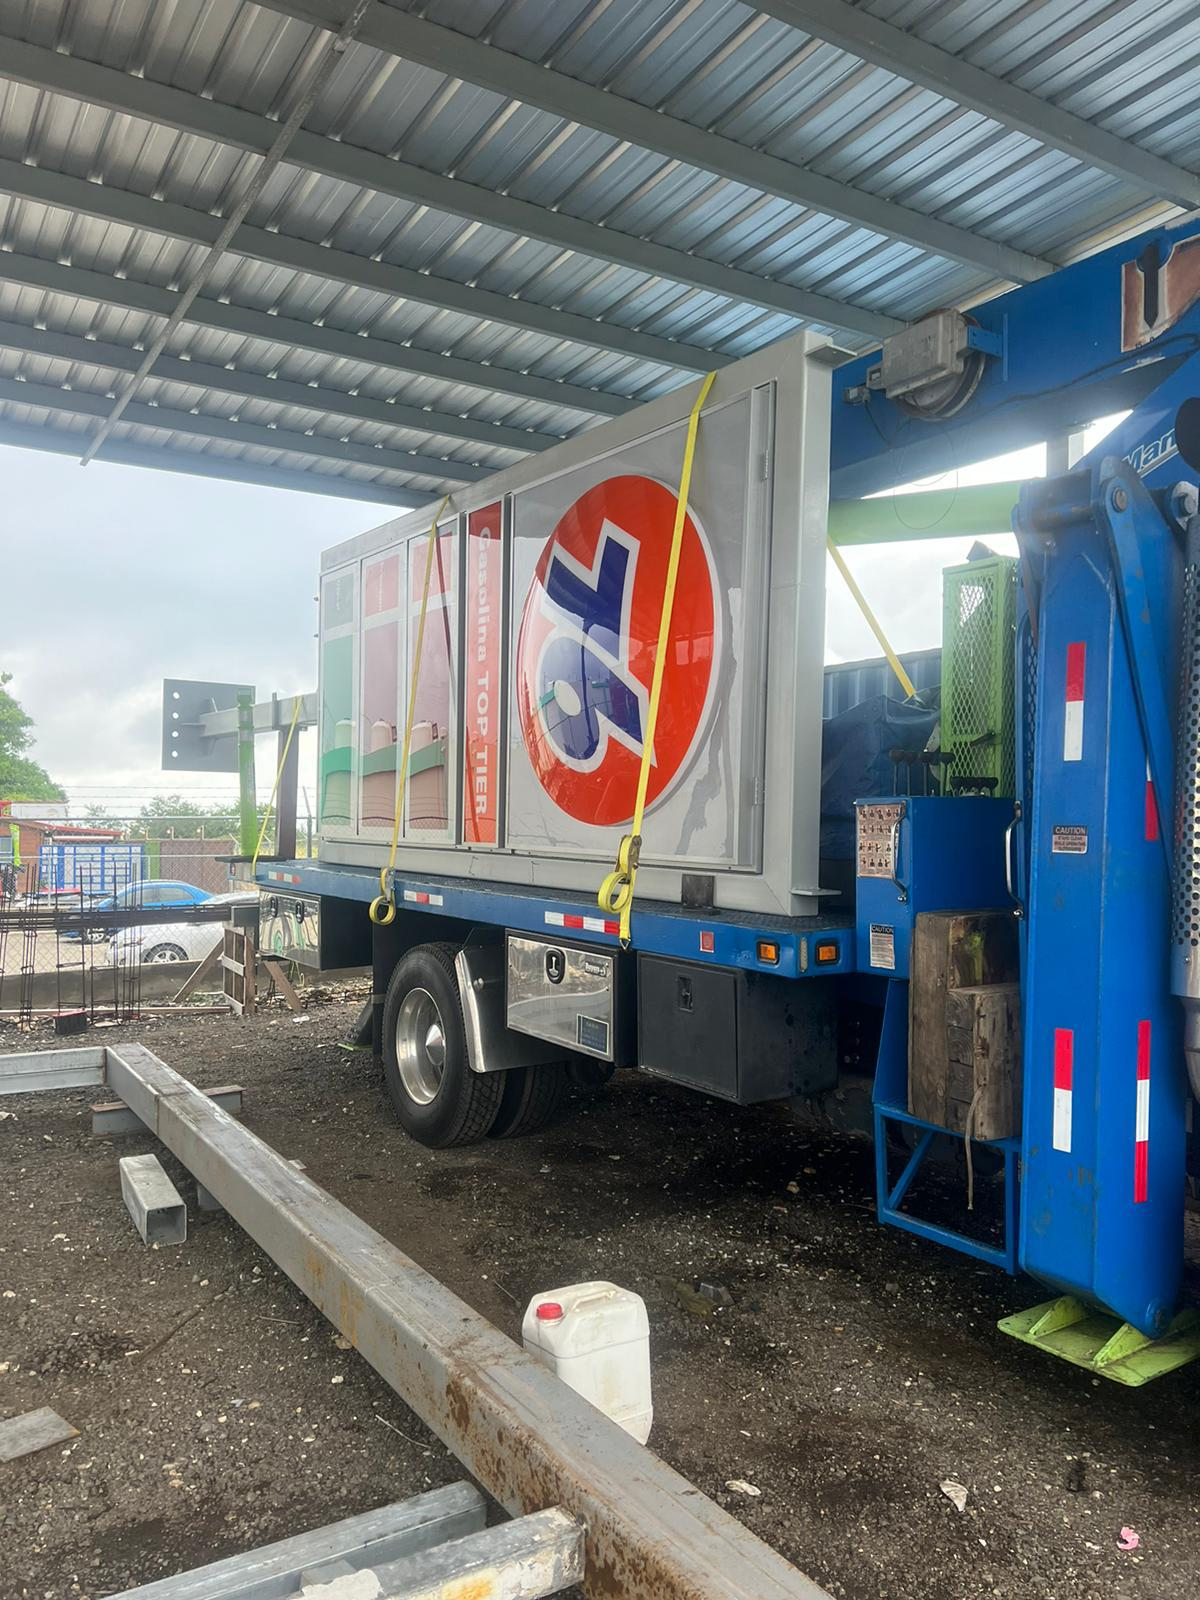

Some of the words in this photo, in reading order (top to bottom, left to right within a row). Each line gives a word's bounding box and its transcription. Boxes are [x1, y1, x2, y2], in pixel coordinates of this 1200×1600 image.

[477, 527, 491, 662] Gasolina
[534, 518, 657, 773] 76
[477, 671, 488, 736] TOP
[475, 745, 488, 814] TIER
[1055, 826, 1086, 834] CAUTION
[871, 926, 894, 934] CAUTION
